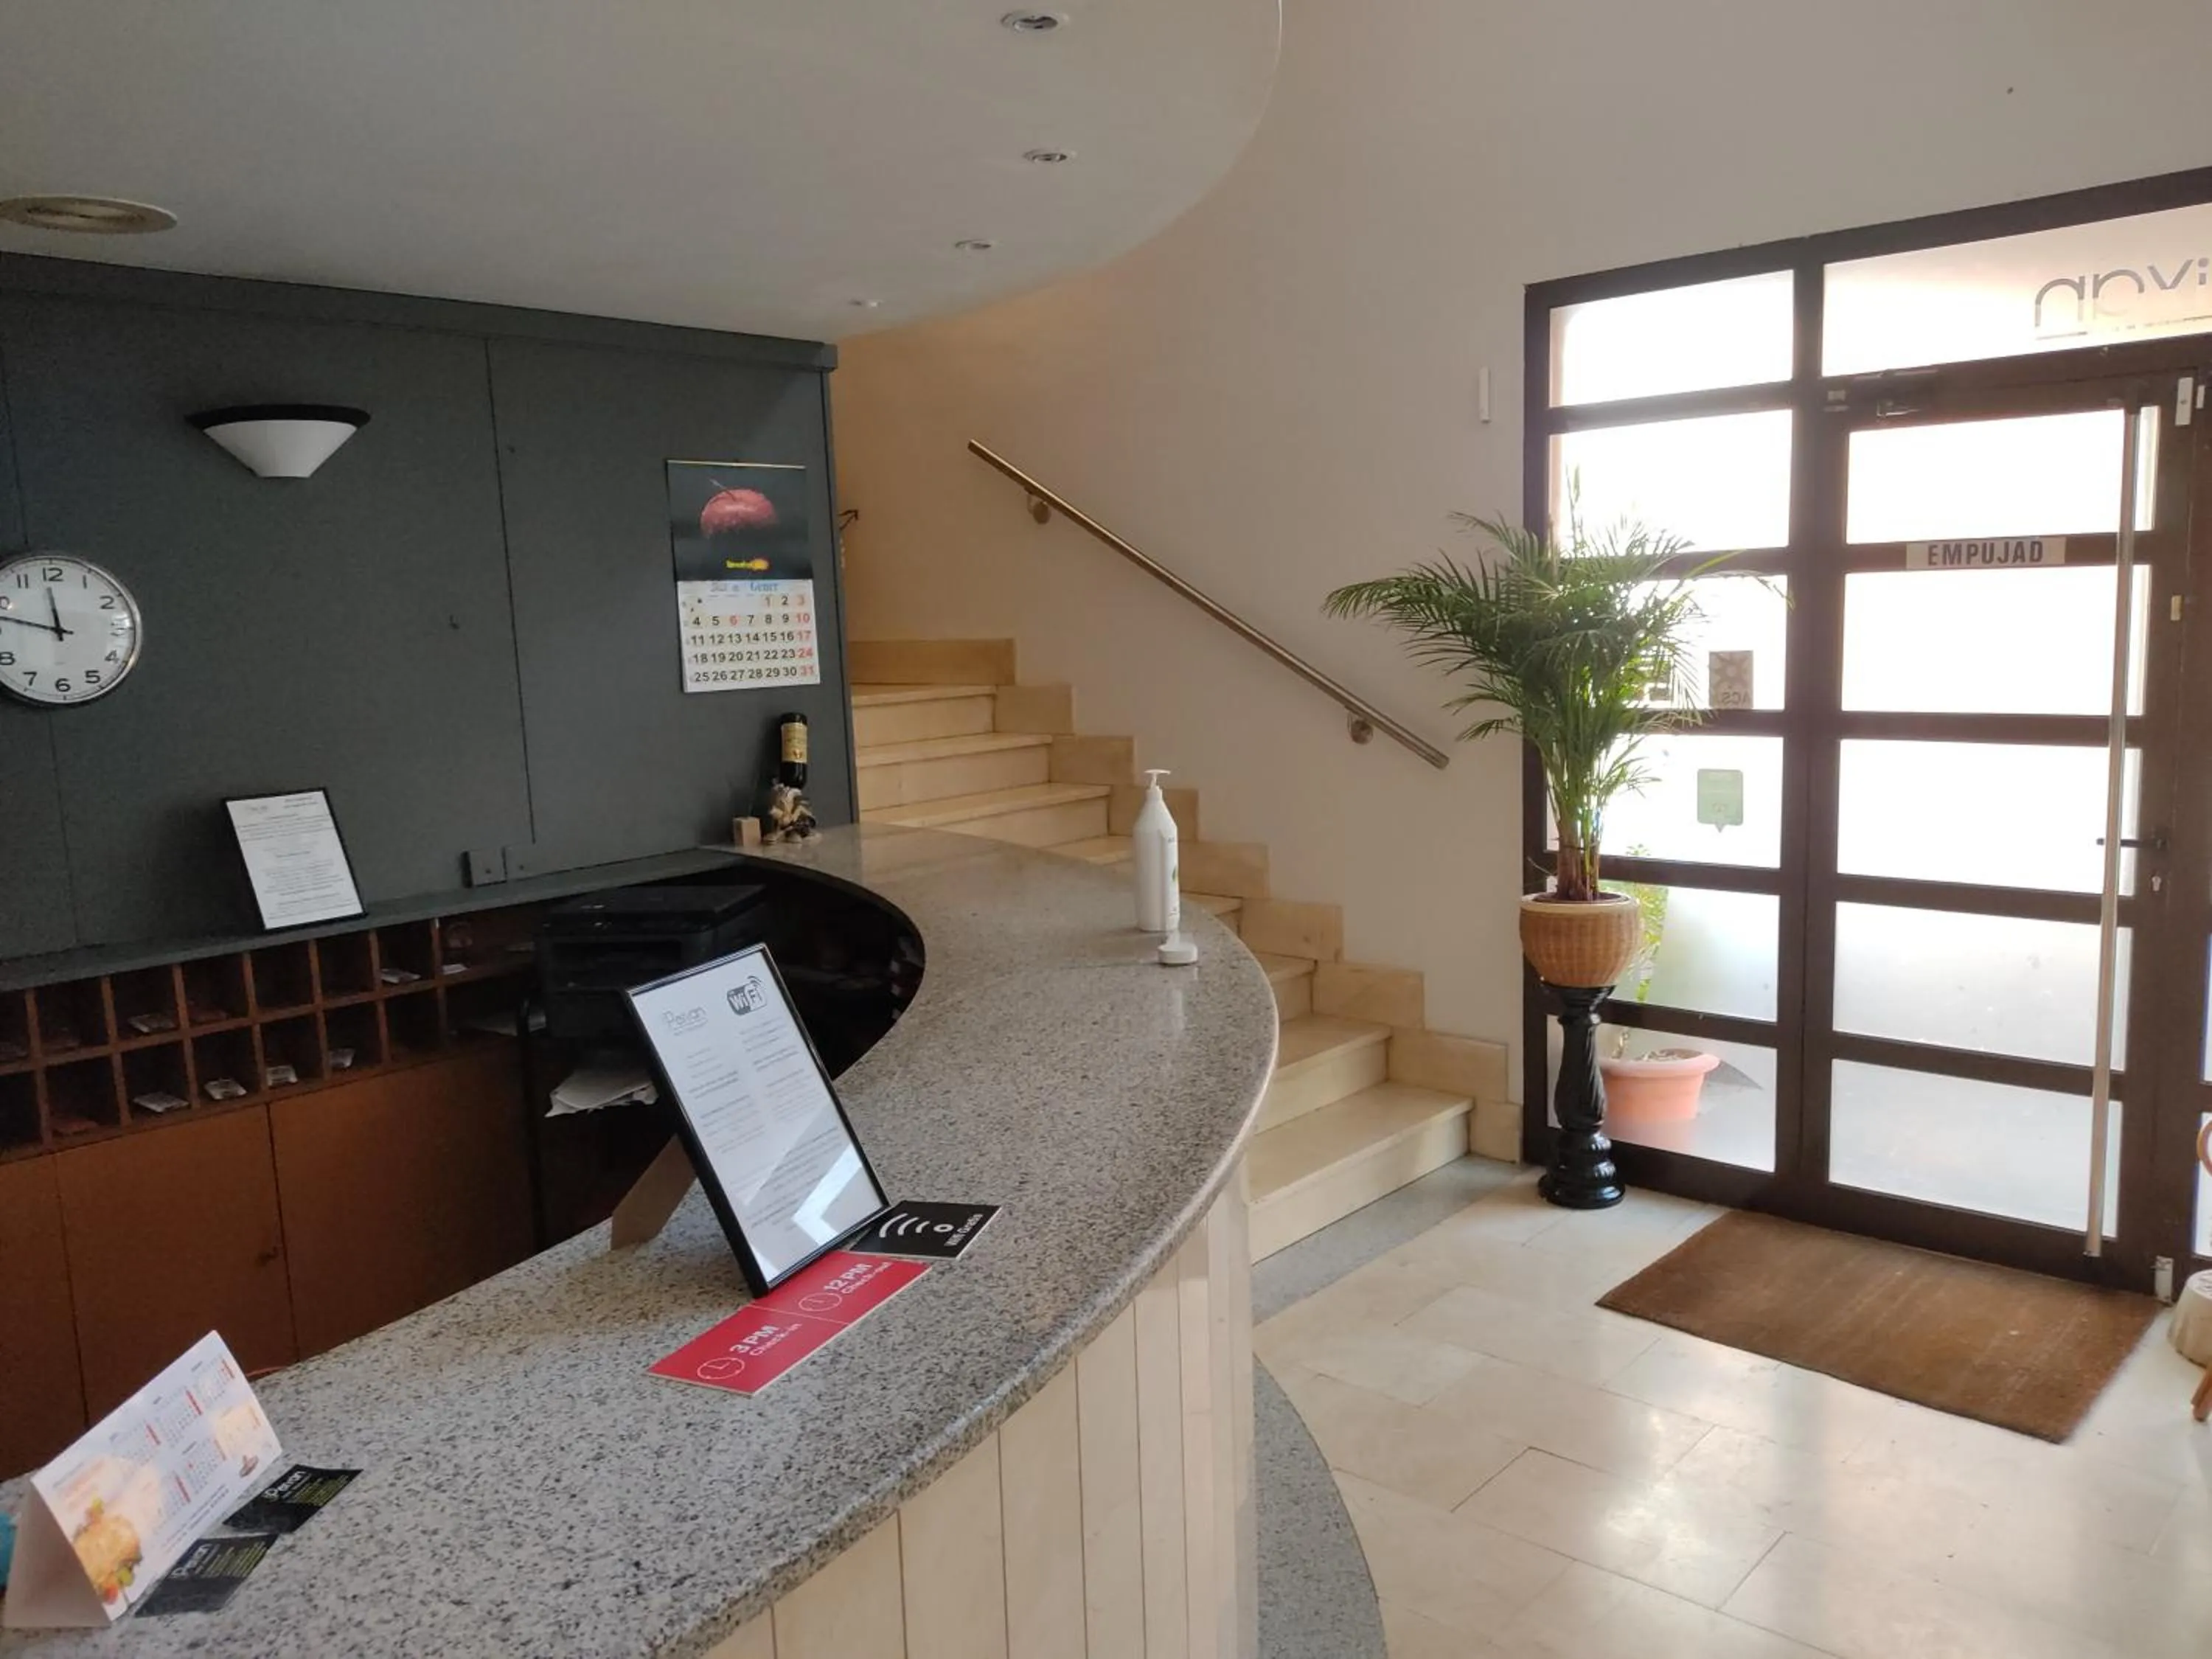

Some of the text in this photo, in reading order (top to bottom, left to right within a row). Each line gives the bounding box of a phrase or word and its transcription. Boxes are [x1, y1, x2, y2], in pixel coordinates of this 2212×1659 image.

[1927, 540, 2043, 566] EMPUJAD
[16, 574, 29, 588] 11
[42, 567, 64, 582] 12
[83, 574, 87, 588] 1
[100, 596, 115, 610] 2
[781, 596, 788, 606] 2
[692, 616, 701, 626] 4
[712, 616, 720, 626] 5
[748, 615, 755, 625] 7
[765, 614, 772, 624] 8
[782, 613, 790, 623] 9
[797, 613, 810, 623] 10
[692, 630, 811, 645] 11 12 13 14 15 16 17
[0, 652, 15, 666] 8
[105, 650, 119, 664] 4
[694, 654, 708, 664] 18
[712, 653, 726, 663] 19
[728, 652, 744, 662] 20
[746, 651, 760, 661] 21
[764, 650, 779, 660] 22
[781, 649, 796, 659] 23
[23, 671, 38, 686] 7
[85, 670, 100, 684] 5
[695, 672, 710, 682] 25
[712, 671, 728, 681] 26
[731, 669, 745, 681] 27
[748, 669, 763, 679] 28
[765, 667, 780, 678] 29
[782, 667, 797, 677] 30
[55, 678, 71, 692] 6
[824, 1263, 872, 1291] 12 PM
[730, 1325, 779, 1354] 3 PM
